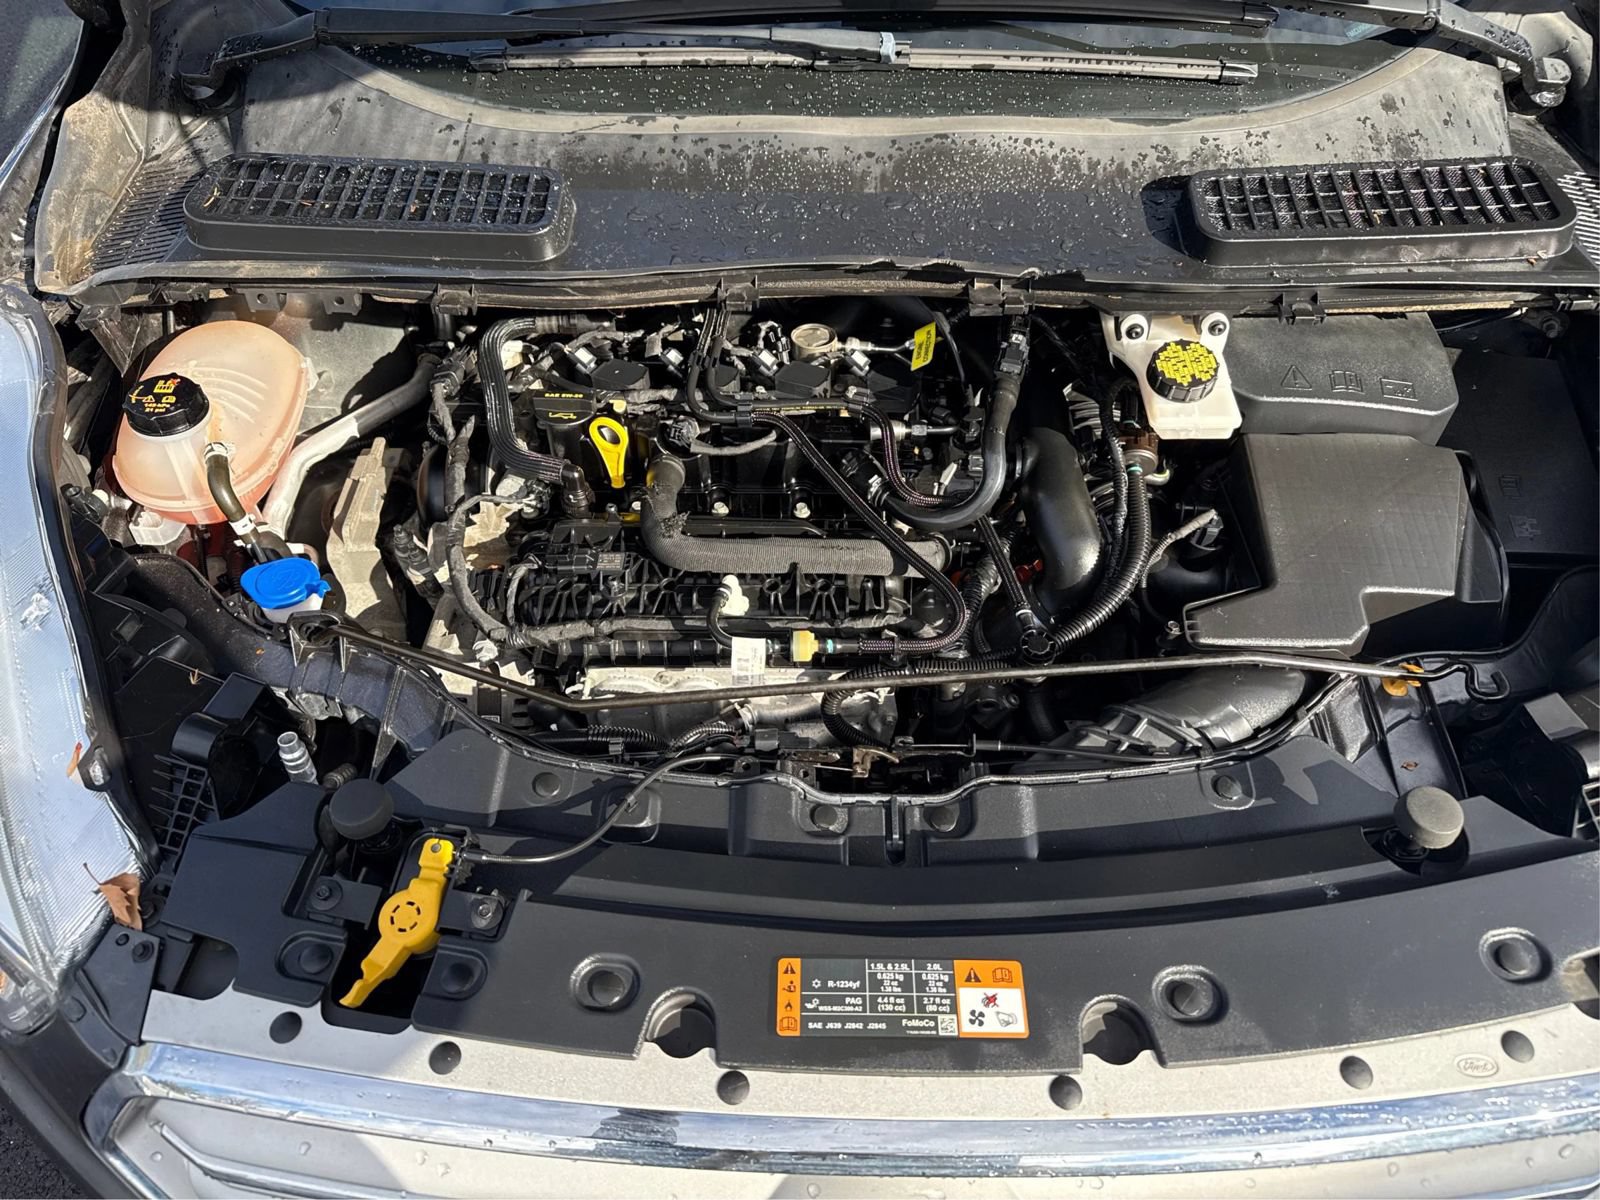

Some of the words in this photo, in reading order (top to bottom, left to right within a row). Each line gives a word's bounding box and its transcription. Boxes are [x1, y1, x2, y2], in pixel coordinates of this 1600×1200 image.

[894, 963, 910, 971] 2.5L
[926, 963, 943, 971] 2.0L
[895, 973, 904, 982] kg
[940, 974, 949, 982] kg
[827, 980, 861, 989] R-1234yf
[845, 997, 863, 1005] PAG
[877, 1004, 894, 1012] (130
[894, 1004, 906, 1012] cc)
[938, 1005, 950, 1013] cc)
[902, 1018, 936, 1028] FoMoCo
